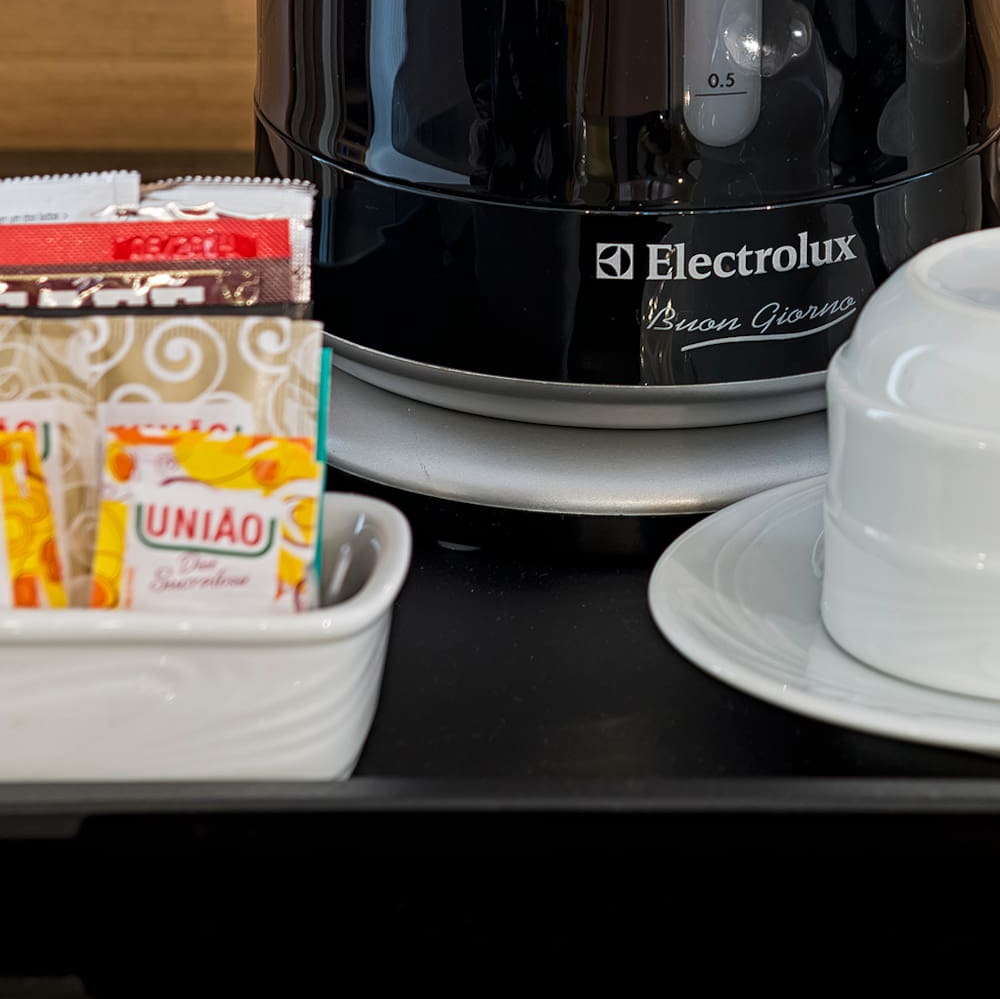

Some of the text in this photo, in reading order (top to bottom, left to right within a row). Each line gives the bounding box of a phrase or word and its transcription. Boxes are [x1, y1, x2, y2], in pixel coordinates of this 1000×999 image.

[708, 73, 736, 89] 0.5
[645, 231, 858, 281] Electrolux
[646, 295, 856, 334] Buon Giorno
[146, 503, 263, 547] UNIÃO
